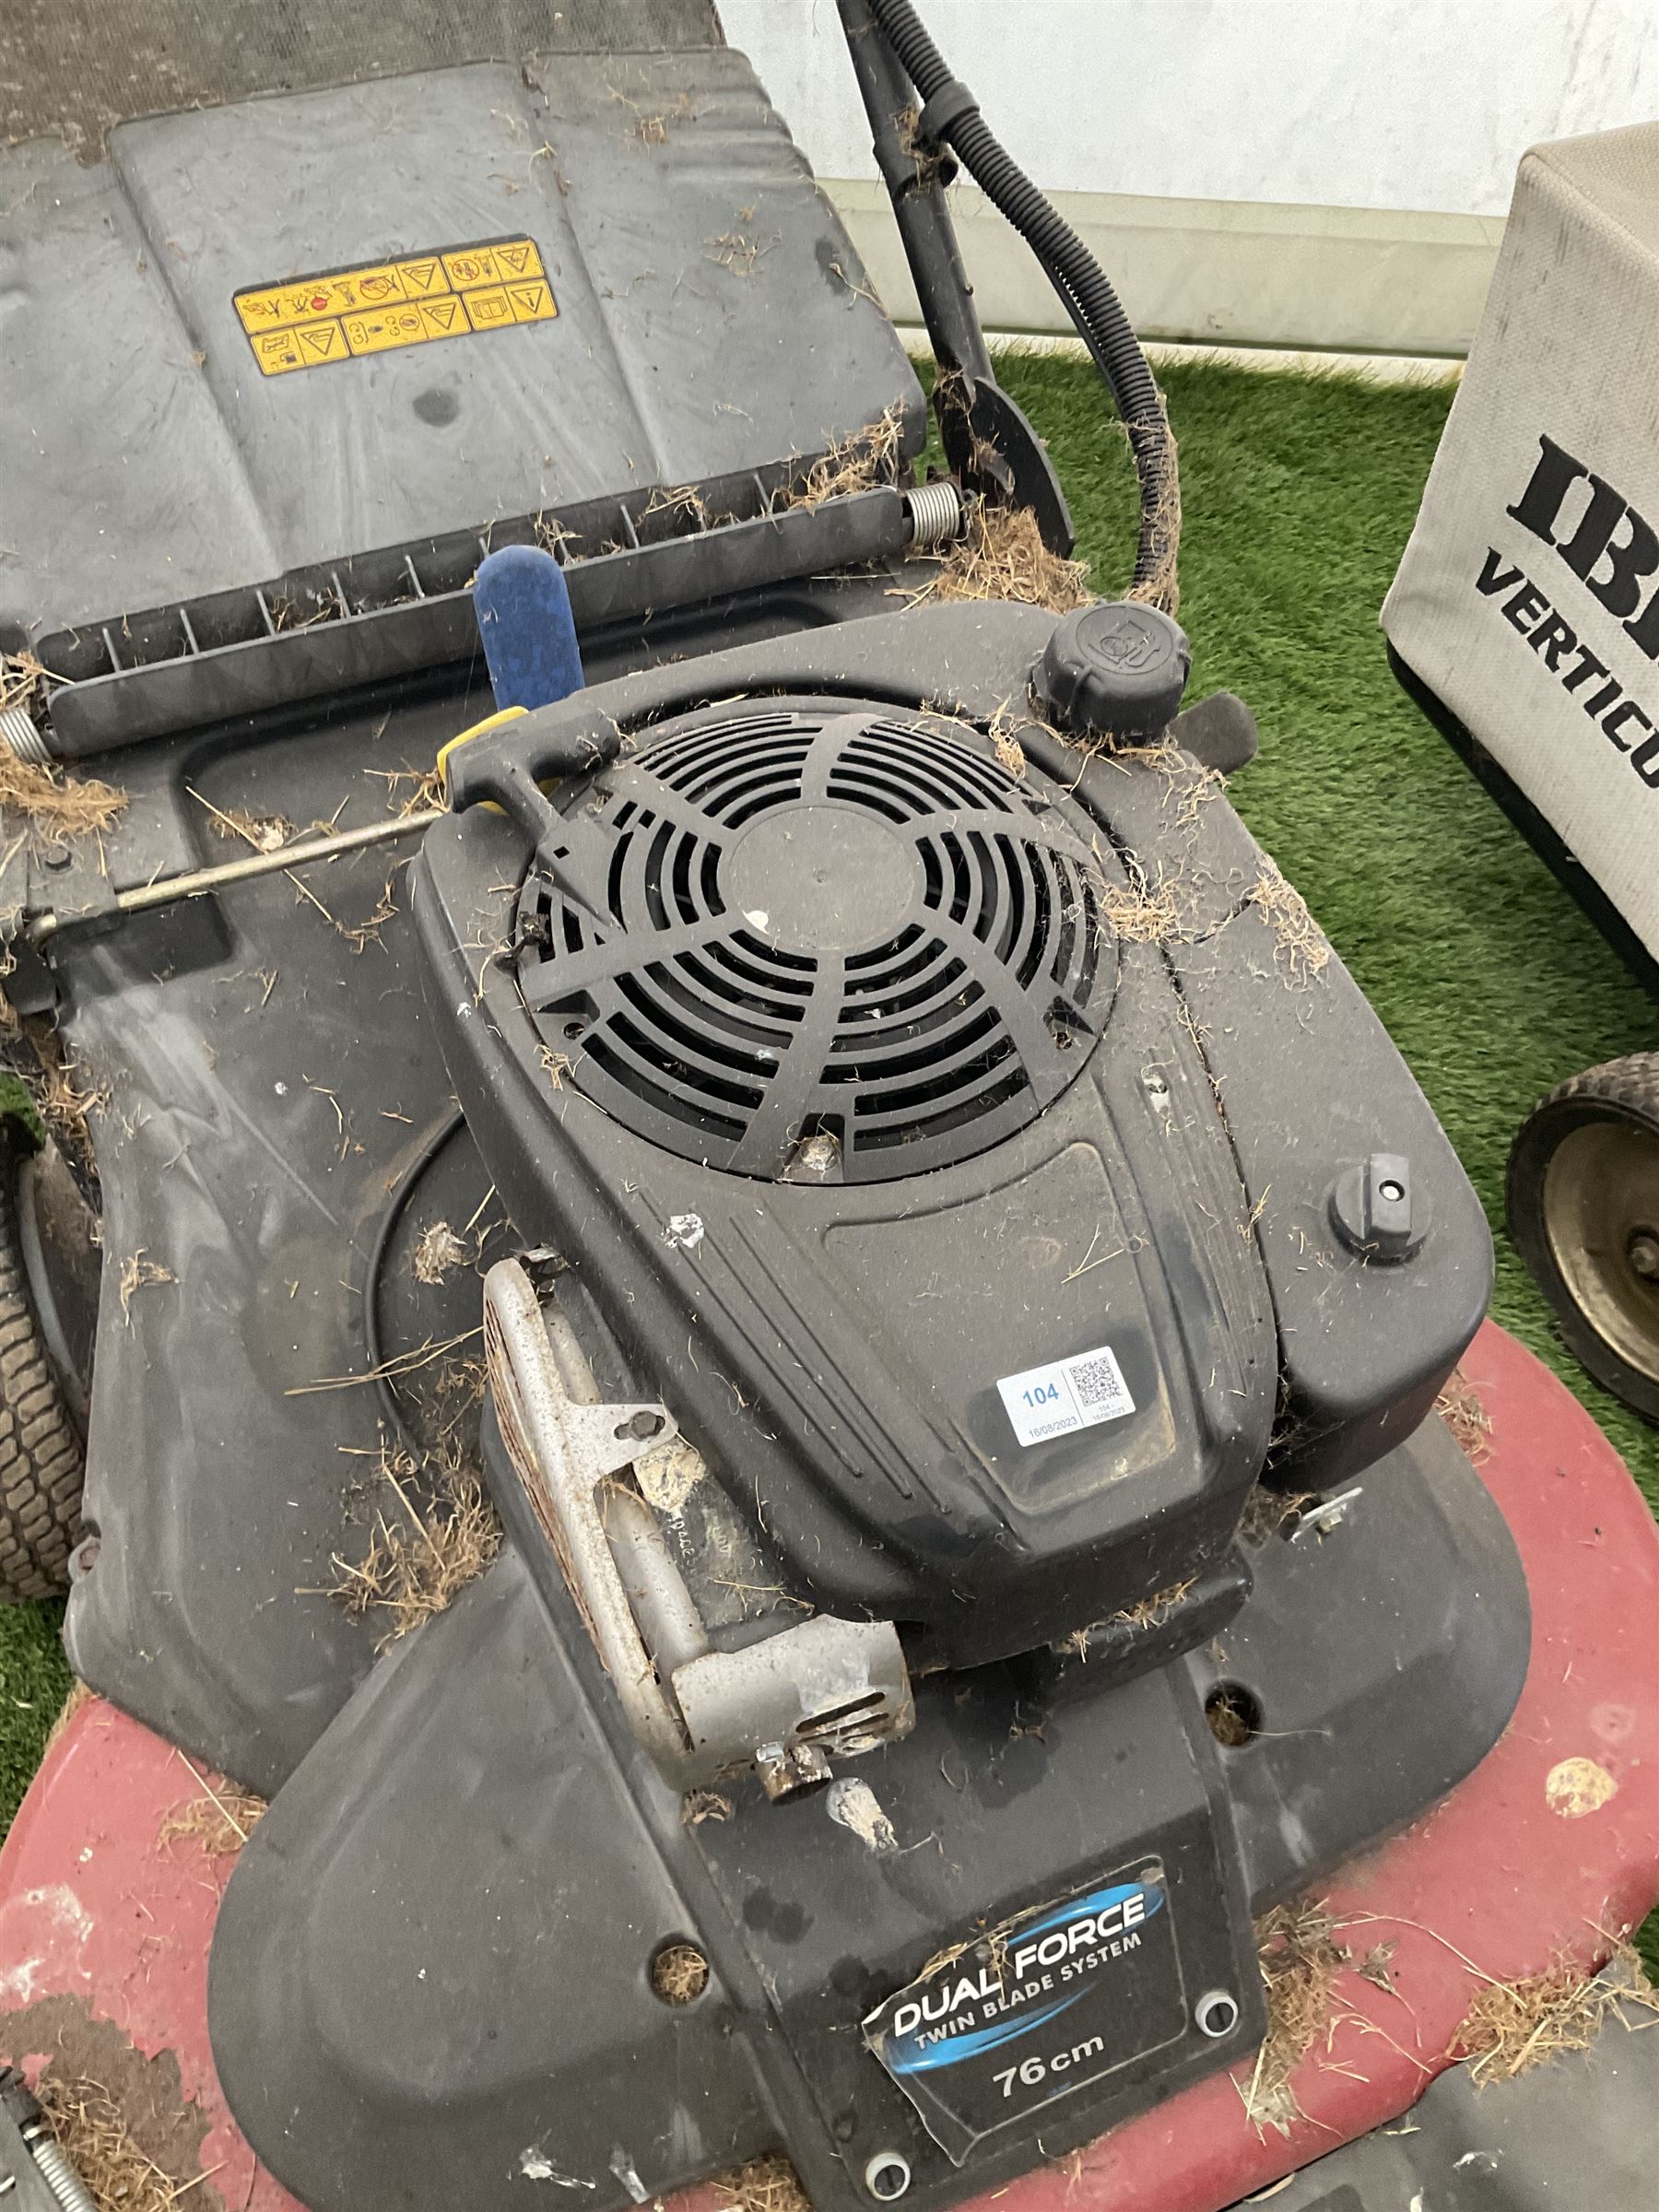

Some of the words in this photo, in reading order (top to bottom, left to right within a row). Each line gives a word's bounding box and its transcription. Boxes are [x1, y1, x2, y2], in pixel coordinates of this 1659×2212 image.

[1506, 433, 1659, 663] IB
[1022, 1383, 1059, 1407] 104
[1029, 1416, 1077, 1439] 16/08/2023
[893, 1966, 1003, 2037] DUAL
[1015, 1893, 1146, 1979] FORCE
[914, 2012, 975, 2051] TWIN
[983, 1973, 1054, 2019] BLADE
[1059, 1933, 1142, 1983] SYSTEM
